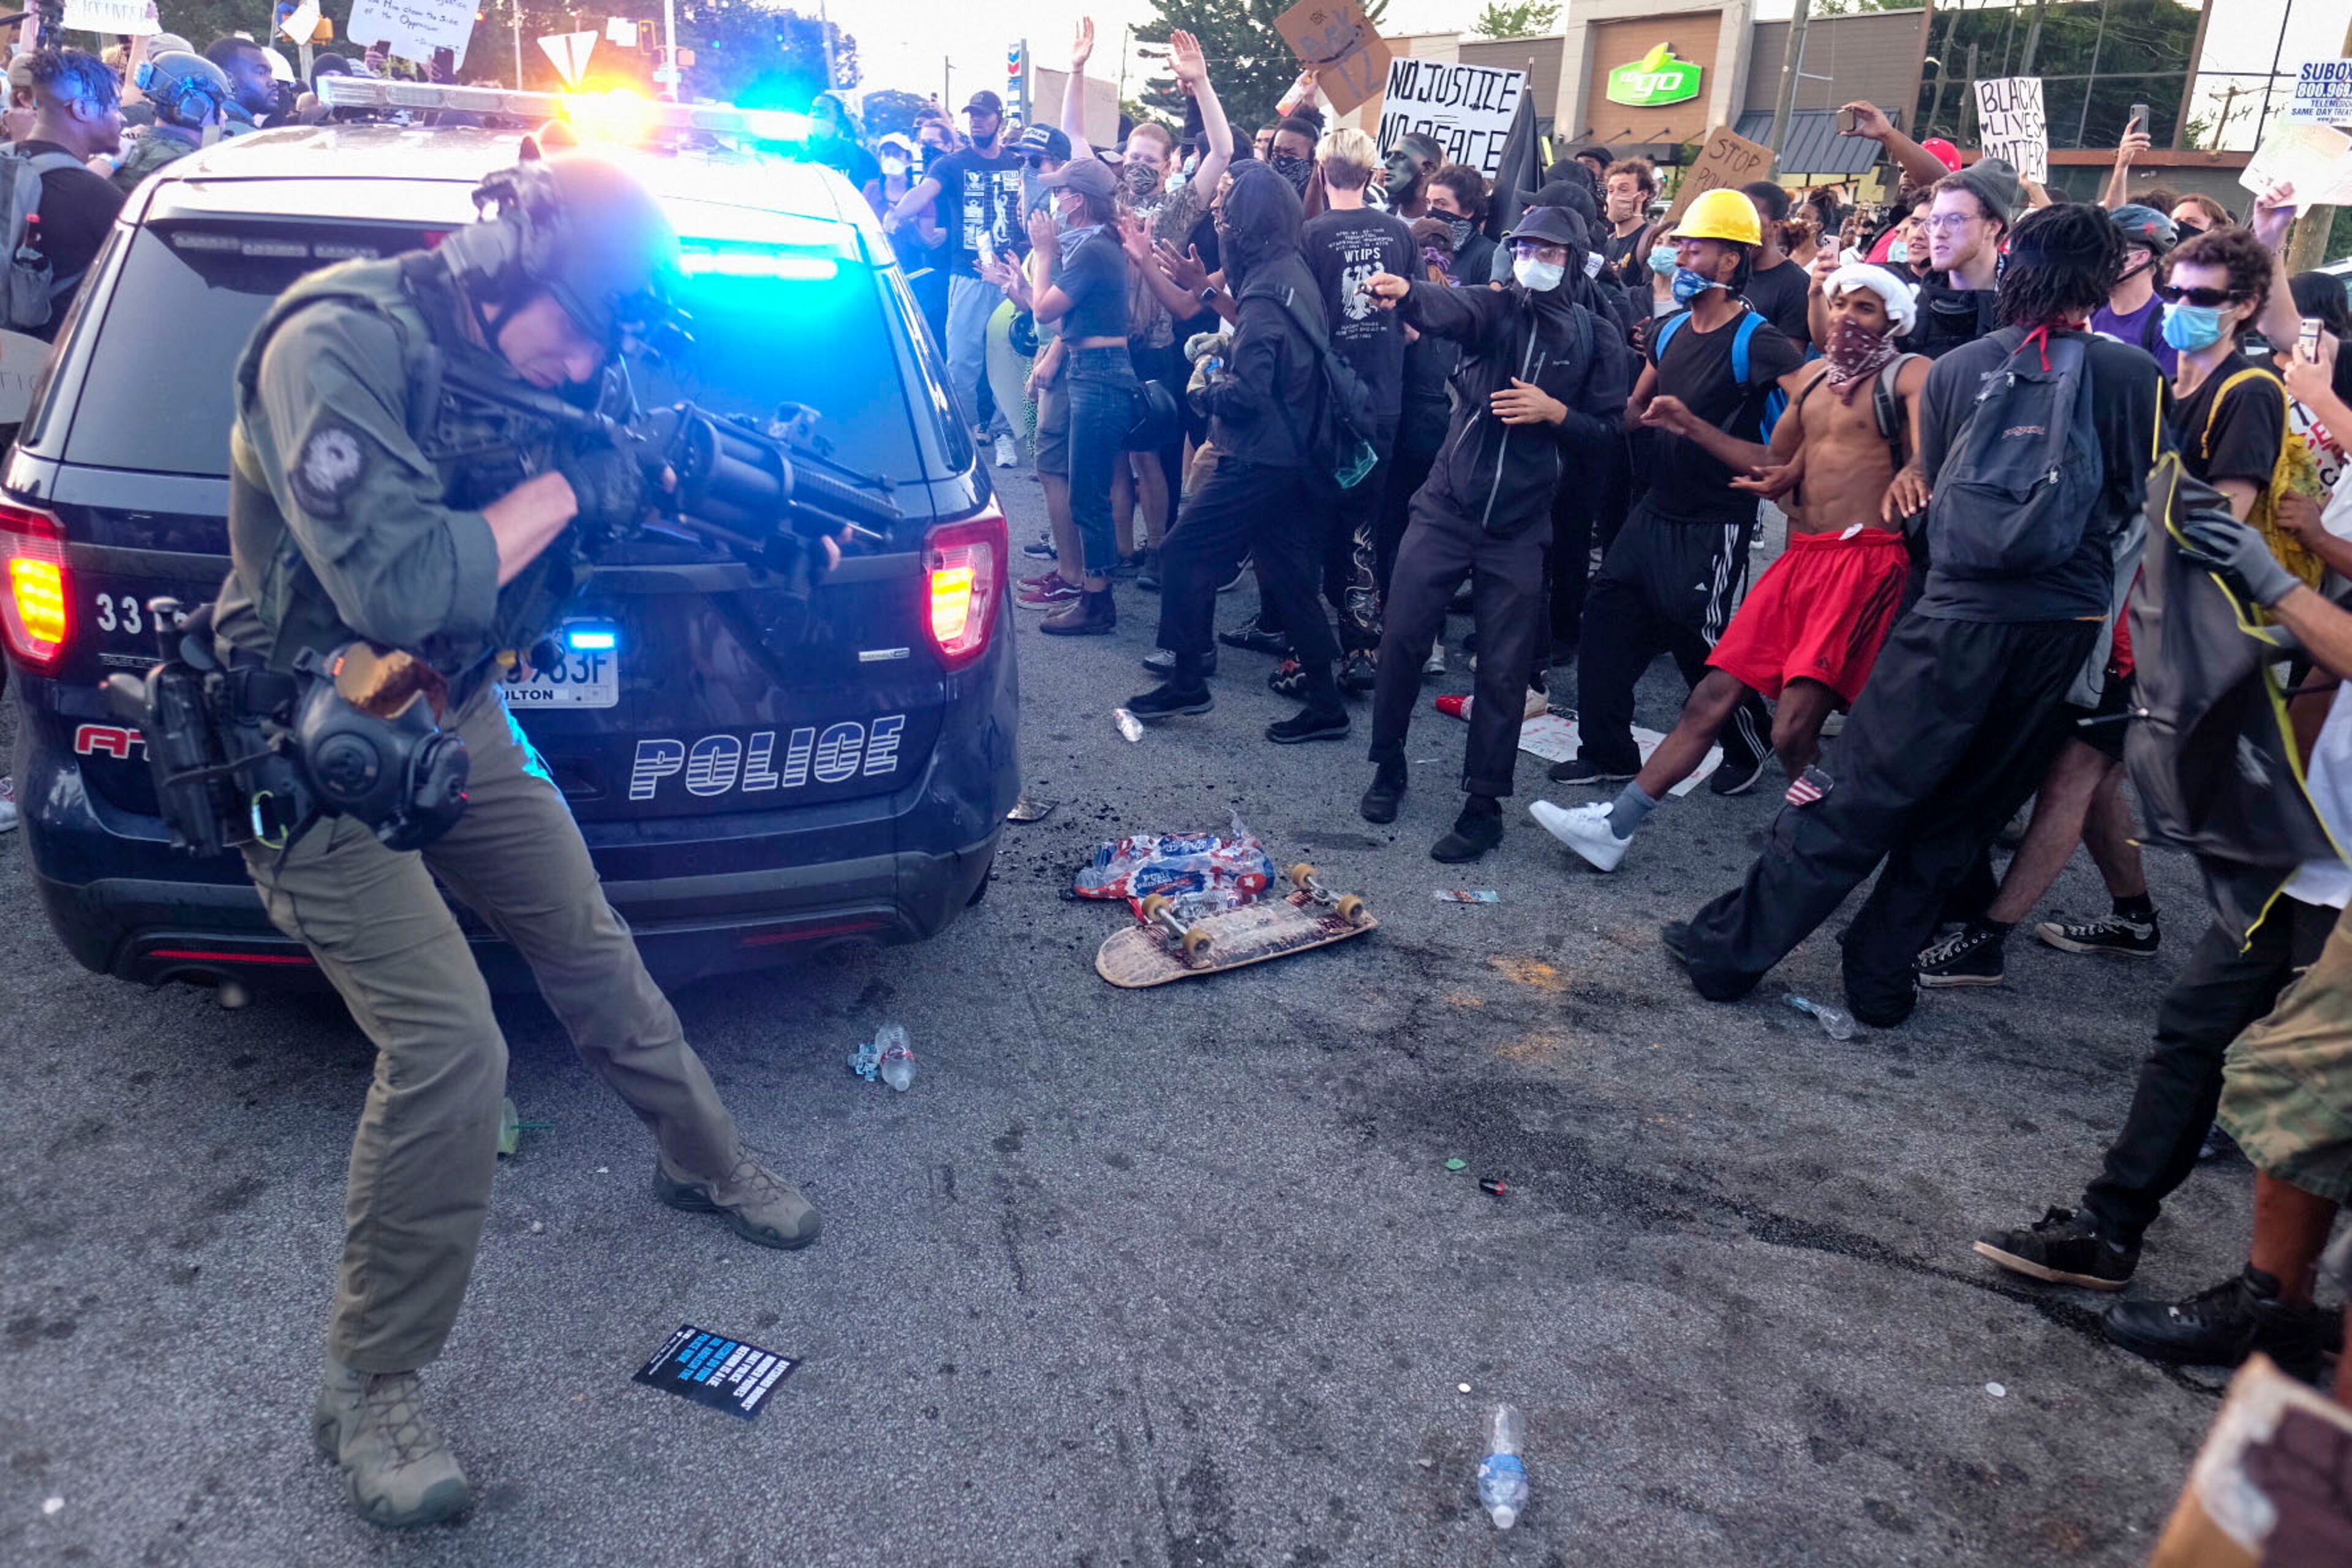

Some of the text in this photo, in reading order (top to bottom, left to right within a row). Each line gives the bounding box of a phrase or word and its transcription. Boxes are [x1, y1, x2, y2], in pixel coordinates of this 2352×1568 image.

[1387, 60, 1521, 115] NO JUSTICE
[1981, 78, 2040, 113] BLACK
[1989, 111, 2041, 138] LIVES
[1709, 138, 1760, 174] STOP
[629, 715, 905, 800] POLICE
